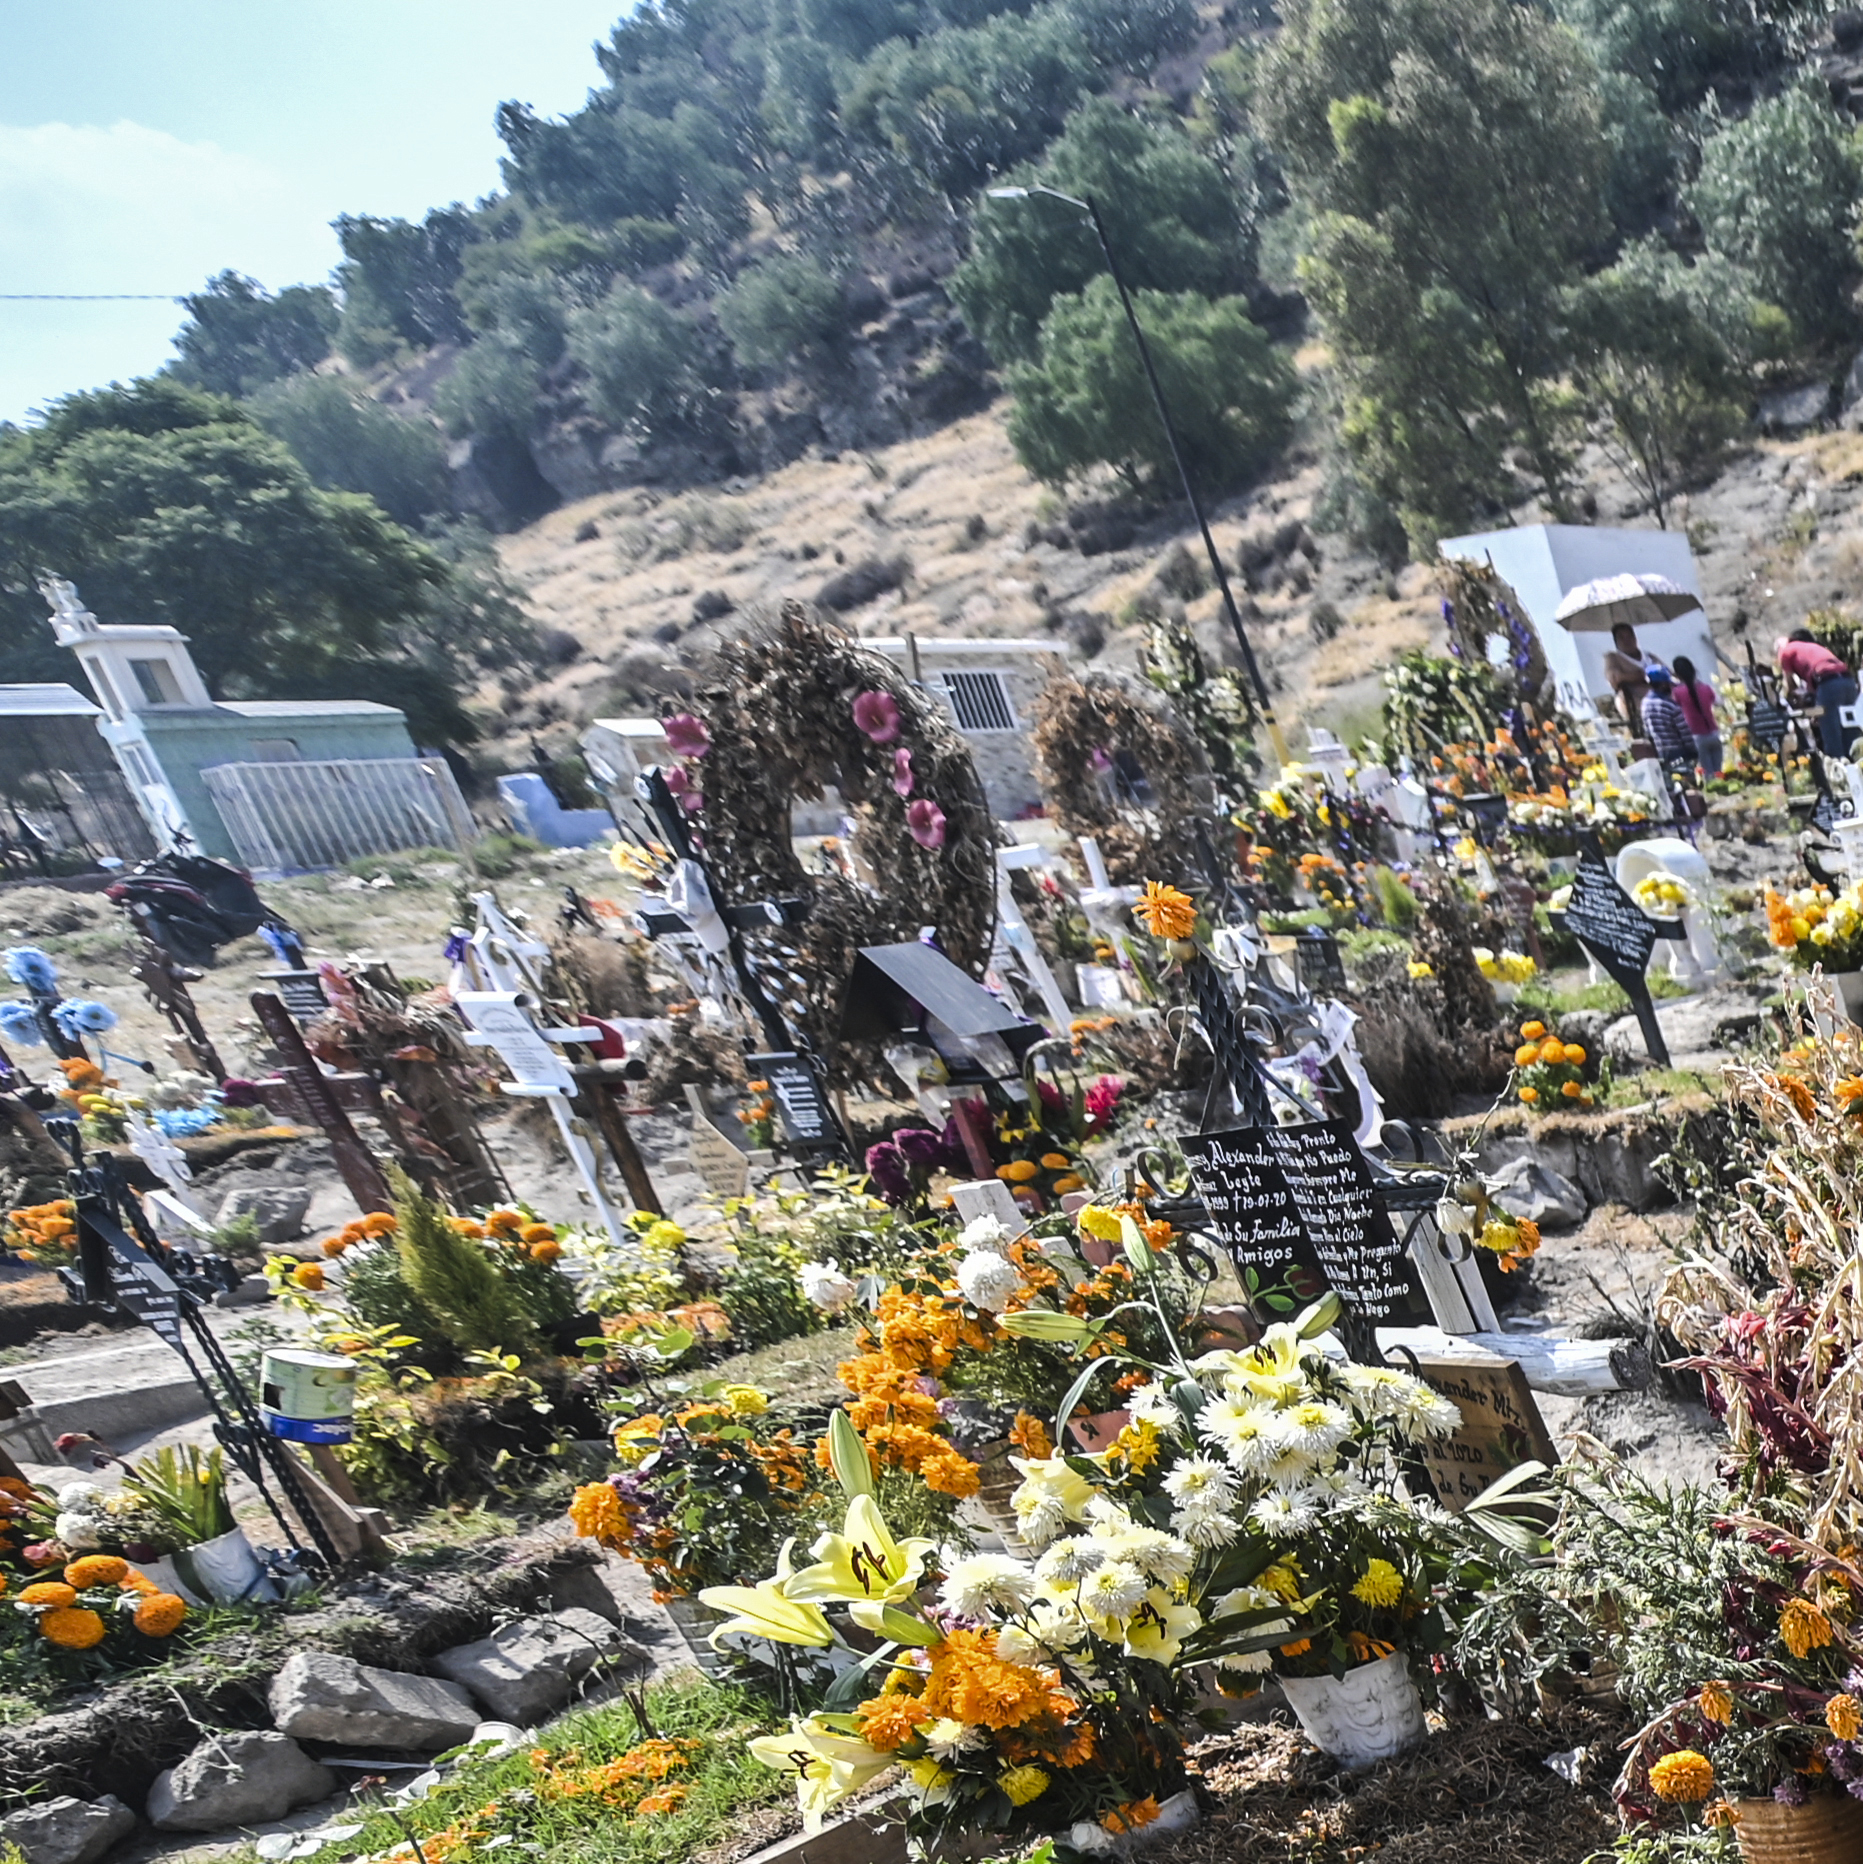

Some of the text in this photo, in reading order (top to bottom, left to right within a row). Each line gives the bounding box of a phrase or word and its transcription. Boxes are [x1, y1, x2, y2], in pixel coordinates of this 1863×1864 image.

[1301, 1129, 1336, 1149] Pronto
[1207, 1140, 1274, 1171] Alexander
[1234, 1221, 1249, 1242] Su
[1249, 1215, 1300, 1243] Familia
[1237, 1246, 1293, 1267] Amigos
[1384, 1281, 1409, 1299] Como
[1437, 1470, 1453, 1494] de
